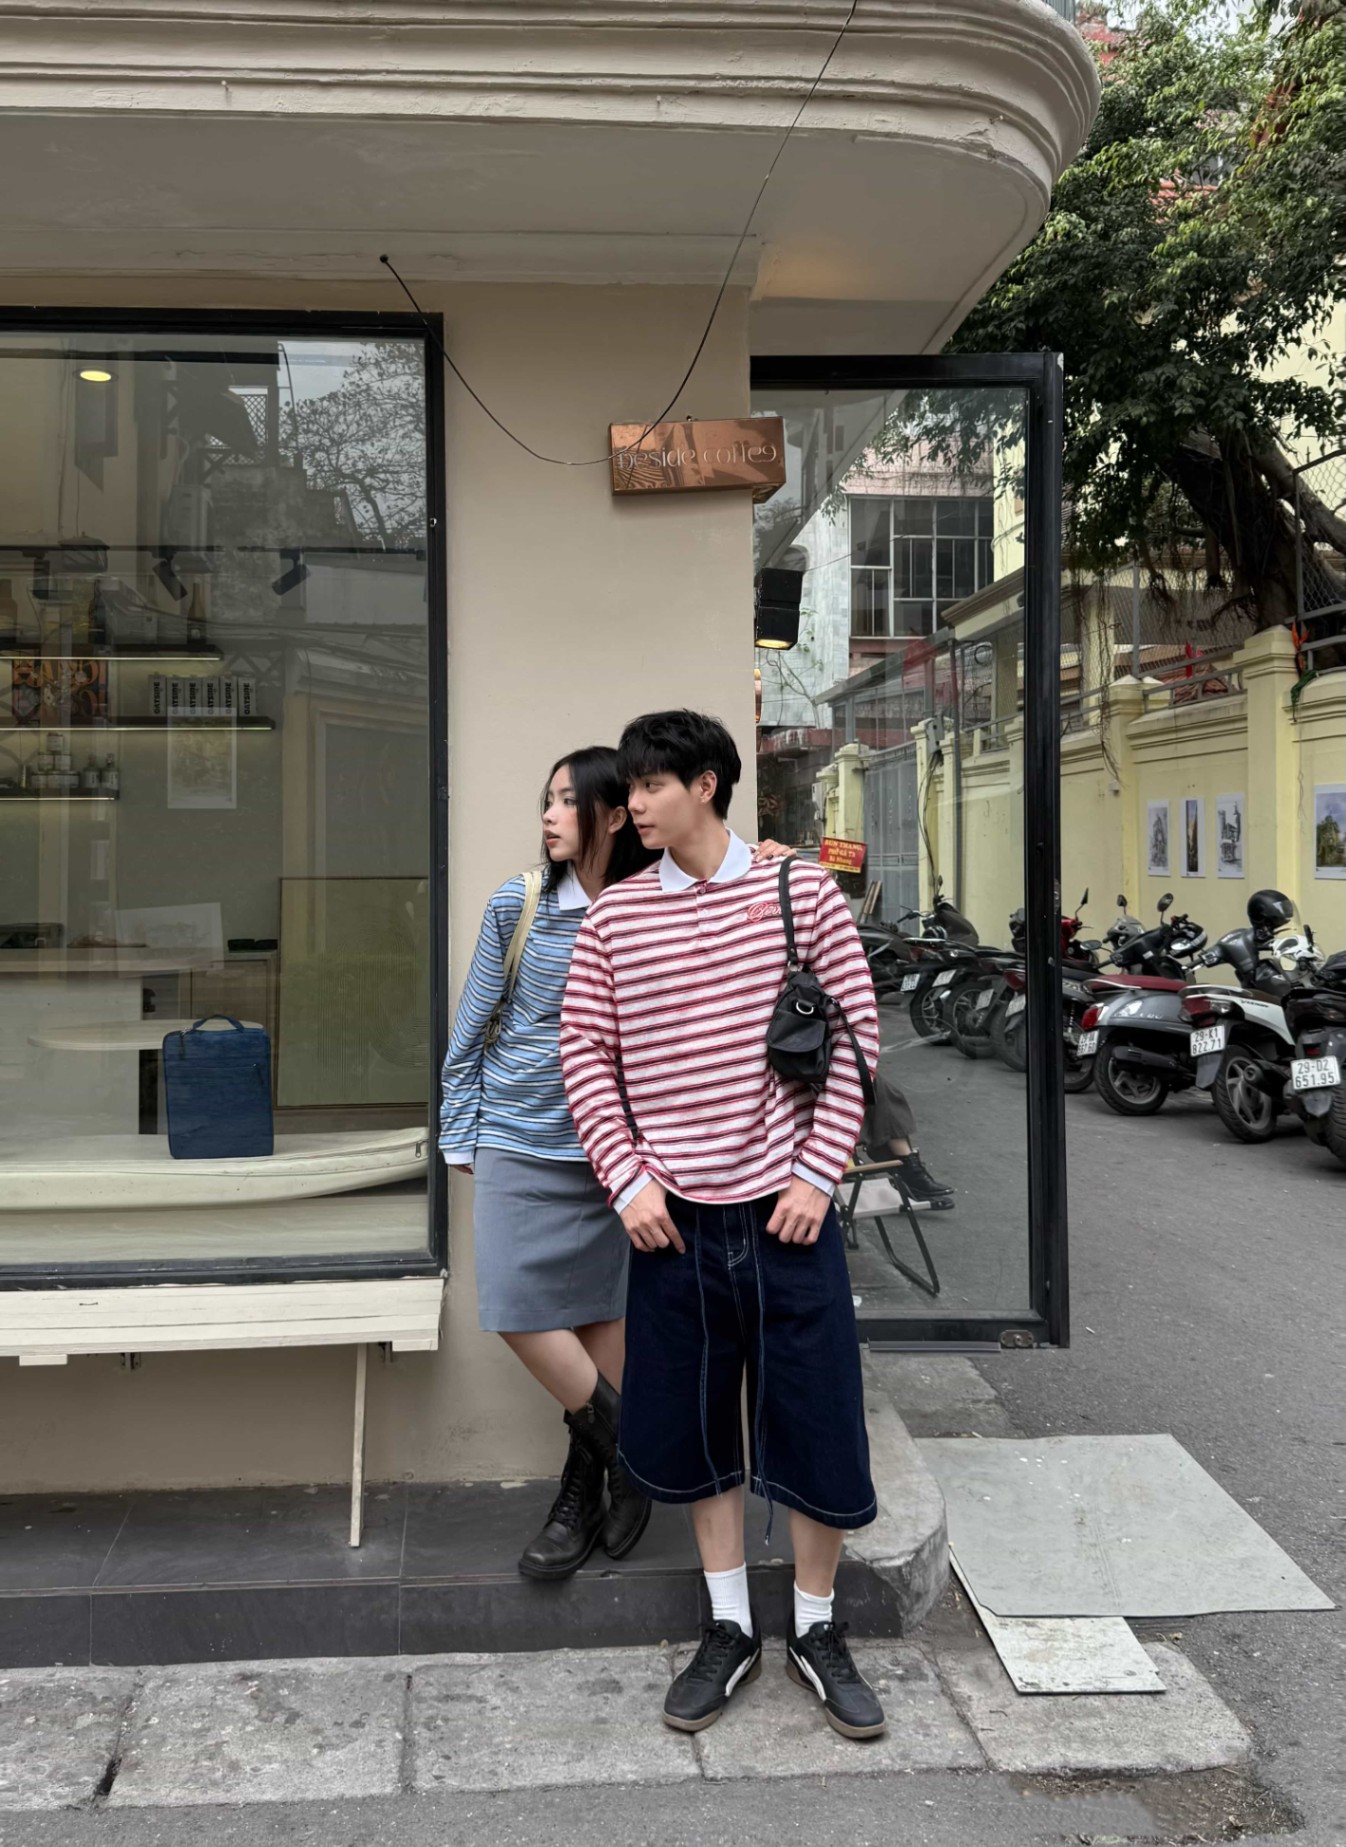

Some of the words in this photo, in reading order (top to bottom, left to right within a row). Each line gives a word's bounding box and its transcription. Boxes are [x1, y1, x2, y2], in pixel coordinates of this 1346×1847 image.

[617, 445, 696, 469] beside
[703, 441, 777, 464] coffee
[153, 681, 161, 714] OATSIDE
[243, 682, 251, 715] OATSIDE
[1195, 1027, 1218, 1042] 29-K1
[1192, 1037, 1221, 1055] 822.71
[1297, 1059, 1329, 1074] 29-D2
[1294, 1071, 1335, 1088] 651.95
